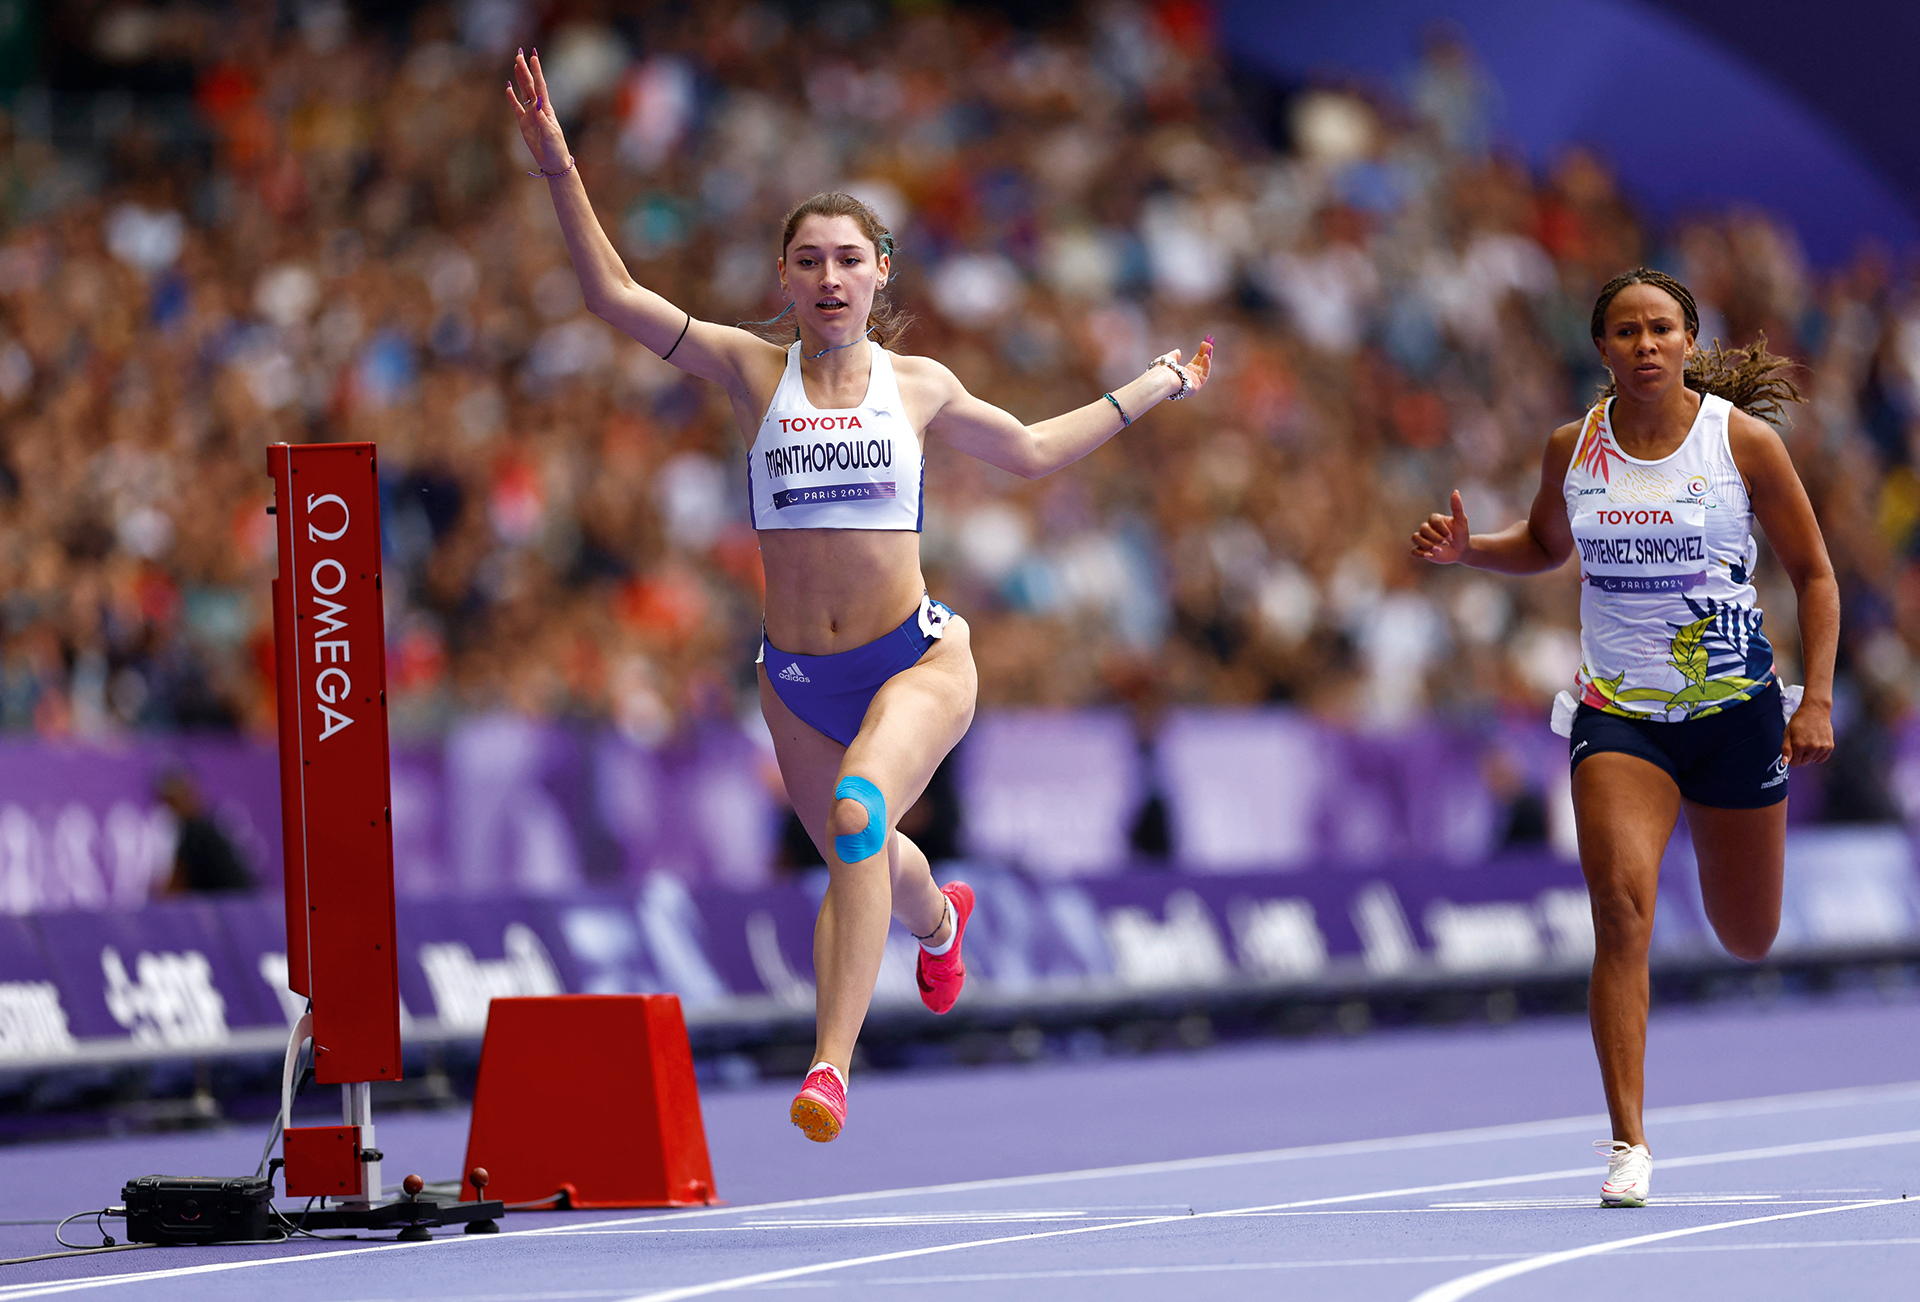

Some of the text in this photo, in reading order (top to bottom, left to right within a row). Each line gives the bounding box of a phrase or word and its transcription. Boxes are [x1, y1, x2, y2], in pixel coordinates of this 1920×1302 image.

[779, 416, 862, 433] TOYOTA
[765, 439, 892, 479] MANTHOPOULOU
[804, 488, 870, 500] PARIS 2024
[1578, 487, 1606, 496] SAETA
[1597, 510, 1674, 525] TOYOTA
[1577, 536, 1704, 565] JIMENEZ SANCHEZ
[1621, 580, 1684, 589] PARIS 2024
[311, 559, 355, 742] OMEGA
[778, 672, 811, 684] adidas
